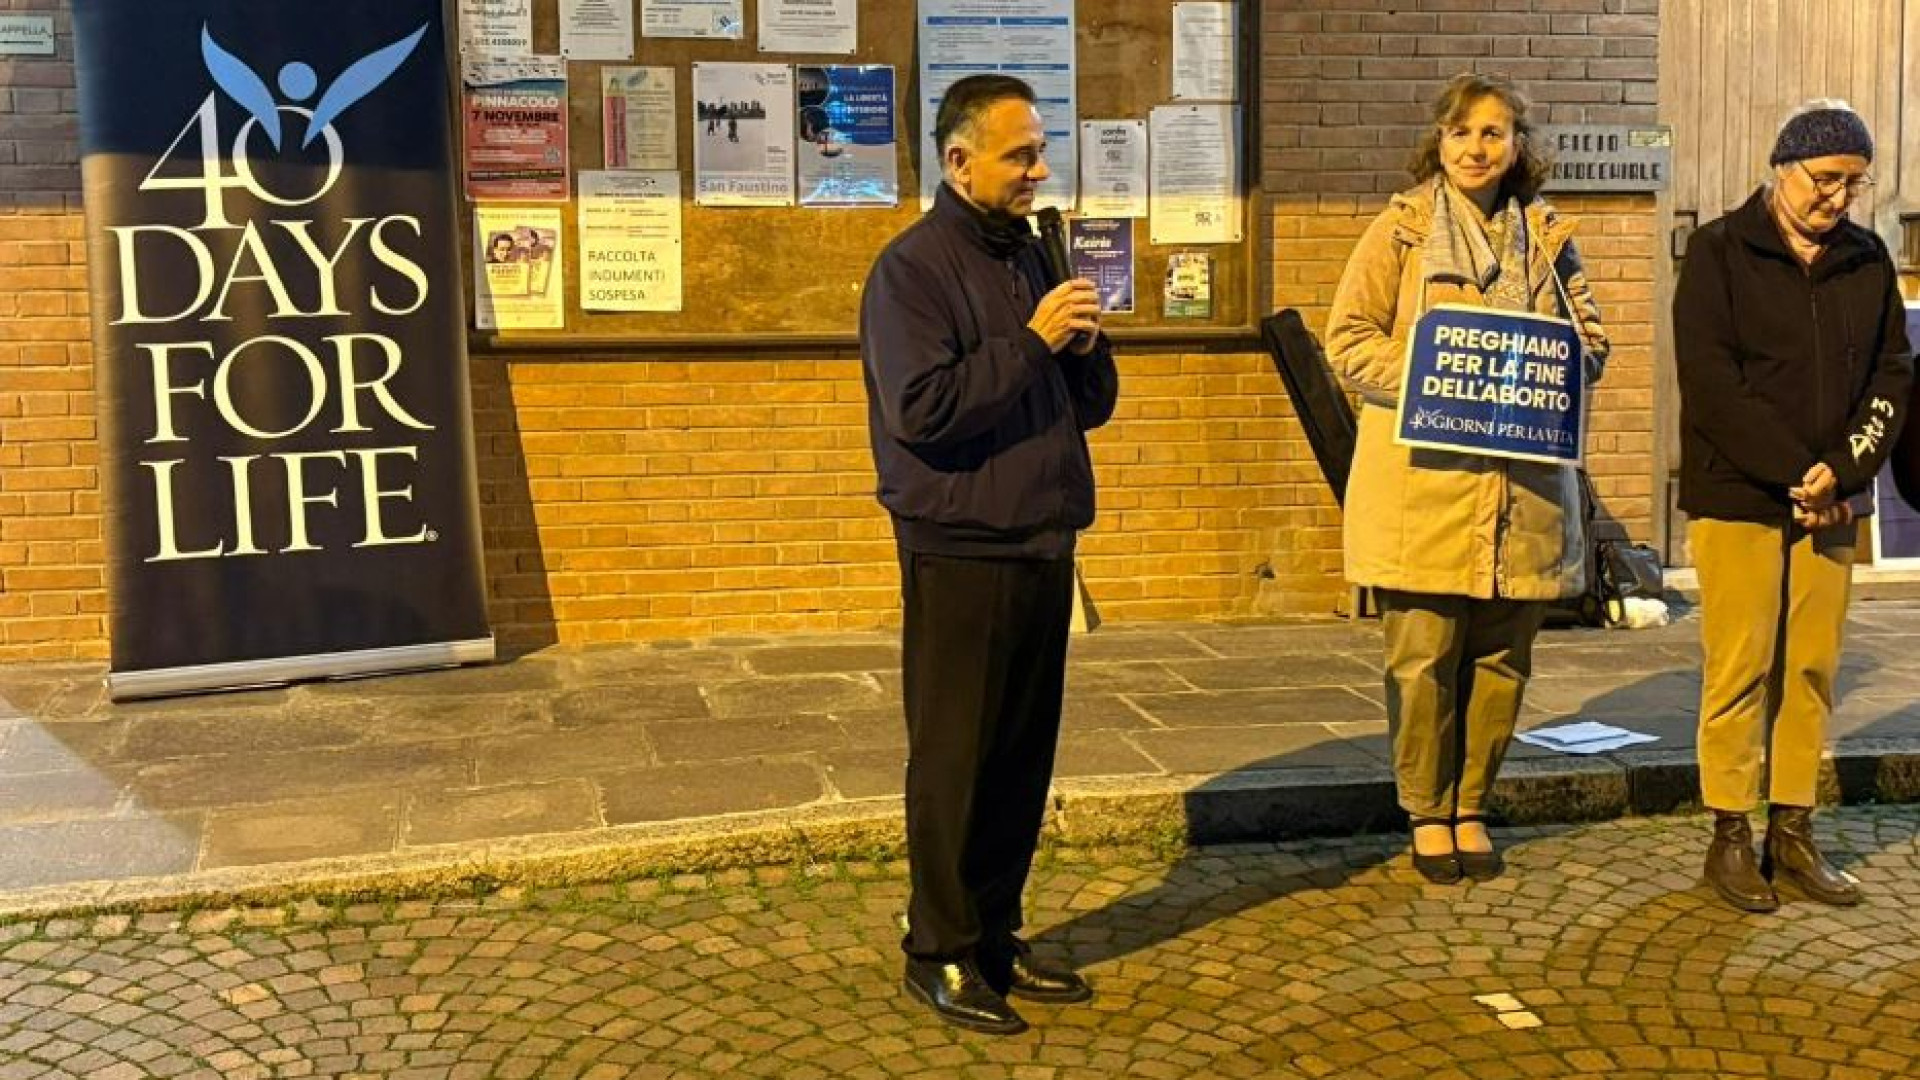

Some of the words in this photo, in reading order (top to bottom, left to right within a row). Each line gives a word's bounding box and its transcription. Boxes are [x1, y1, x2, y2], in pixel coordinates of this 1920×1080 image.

[0, 24, 48, 36] APPELLA
[471, 96, 559, 108] PINNACOLO
[841, 106, 888, 114] NTERIORE
[472, 111, 481, 122] 7
[484, 111, 560, 122] NOVEMBRE
[1558, 134, 1619, 153] FICIO
[139, 91, 344, 229] 40
[1552, 162, 1662, 181] RROCCHIALE
[700, 179, 725, 192] San
[730, 179, 788, 192] Faustino
[588, 250, 657, 262] RACCOLTA
[105, 215, 429, 326] DAYS
[588, 269, 666, 283] INDUMENTI
[588, 289, 647, 301] SOSPESA
[1434, 325, 1569, 361] PREGHIAMO
[1436, 351, 1482, 376] PER
[1488, 357, 1517, 379] LA
[1524, 362, 1567, 387] FINE
[135, 333, 436, 443] FOR
[1422, 376, 1571, 413] DELL'ABORTO
[1498, 422, 1526, 440] PER
[1544, 427, 1574, 446] VITA
